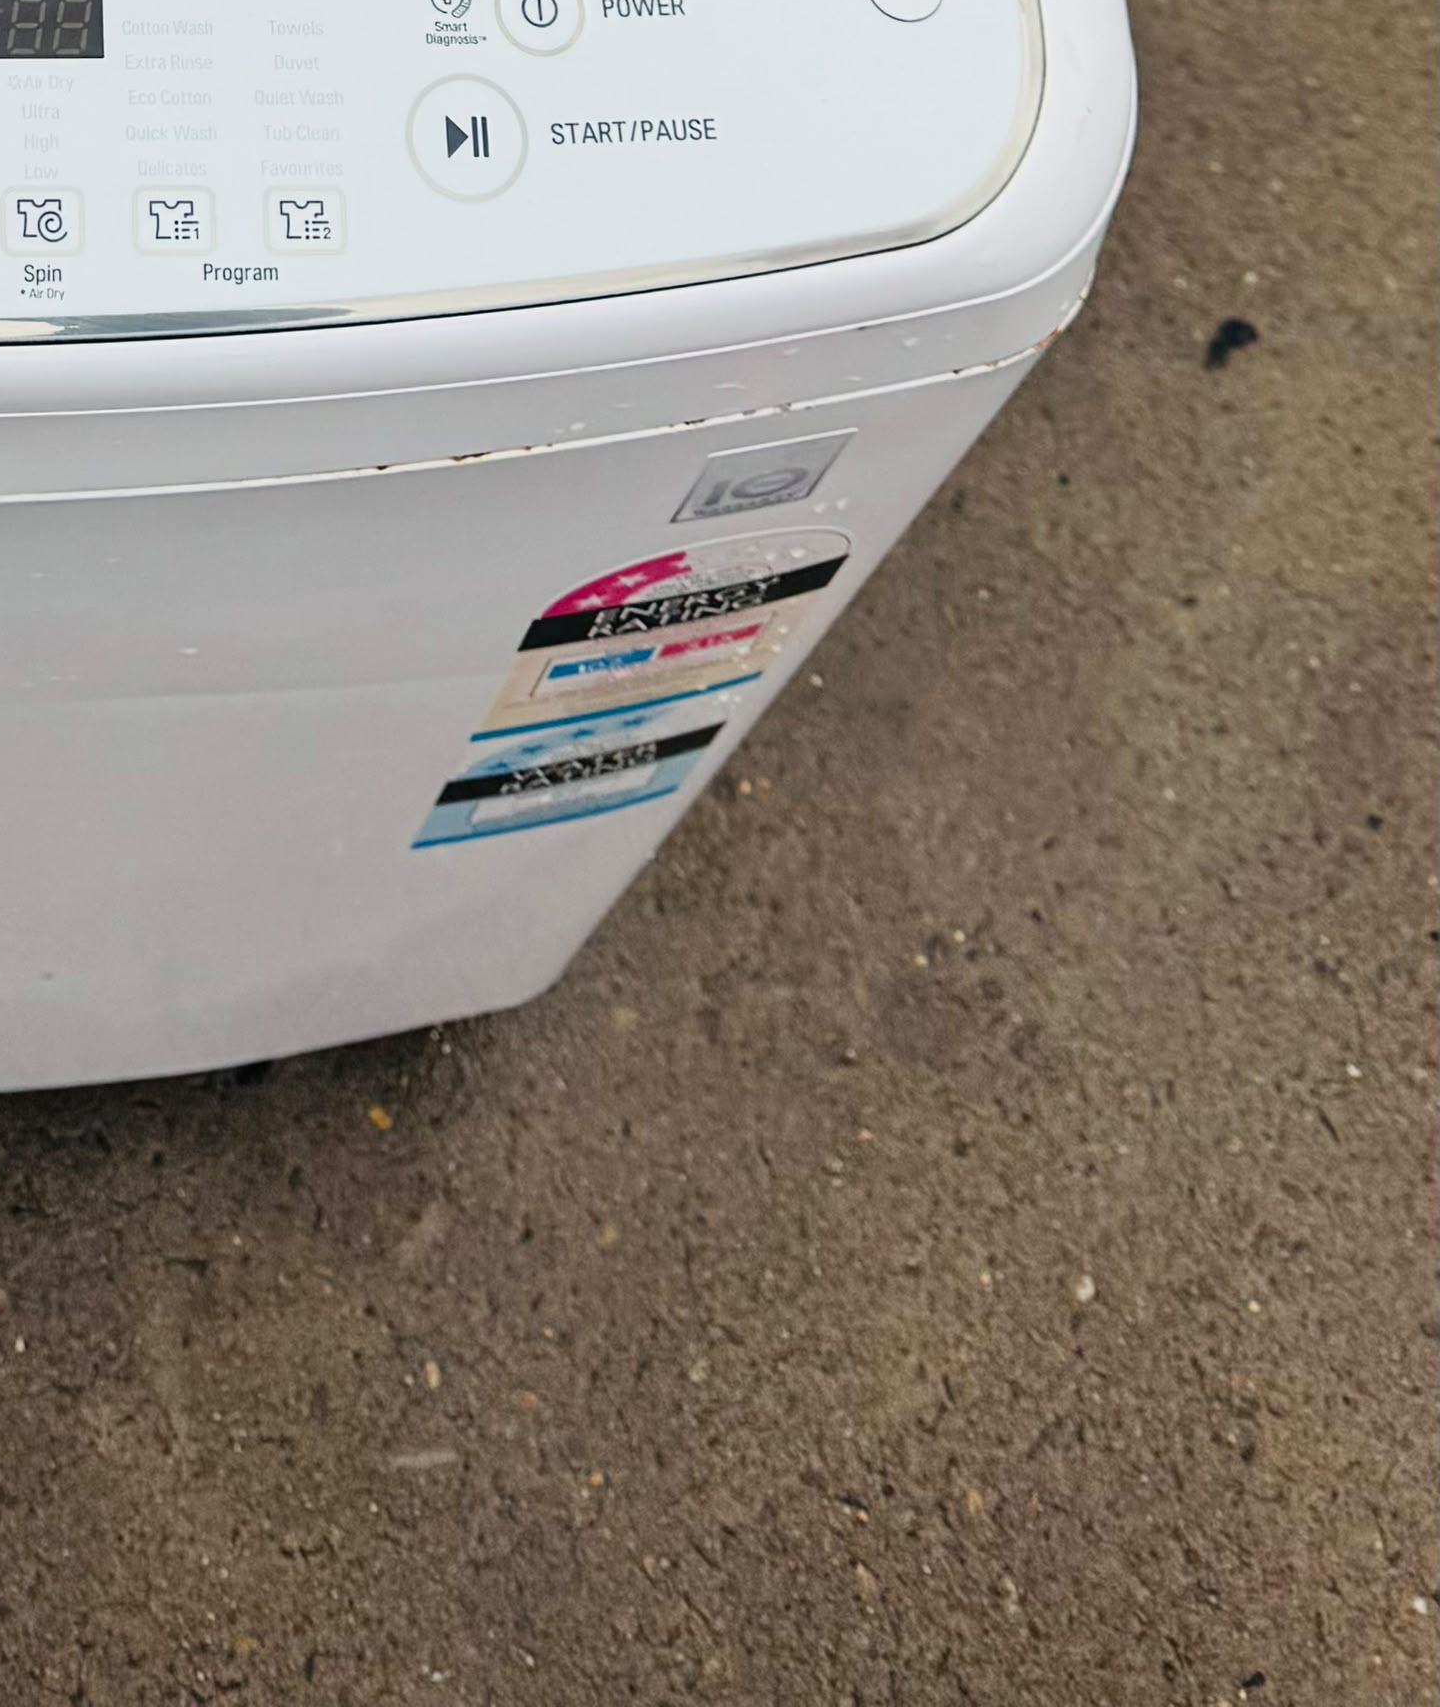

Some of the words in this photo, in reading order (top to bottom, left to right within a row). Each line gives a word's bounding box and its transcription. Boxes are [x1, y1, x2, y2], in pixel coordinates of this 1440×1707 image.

[121, 19, 169, 36] Cotton
[172, 19, 213, 36] Wash
[269, 19, 324, 36] Towels
[435, 21, 468, 33] Smart
[124, 54, 167, 70] Extra
[170, 54, 213, 70] Rinse
[274, 54, 320, 70] Duvet
[23, 75, 42, 90] Air
[48, 75, 75, 92] Dry
[128, 90, 156, 106] Eco
[160, 89, 212, 106] Cotton
[254, 90, 295, 107] Quiet
[299, 89, 344, 106] Wash
[21, 103, 60, 120] Ultra
[125, 124, 168, 141] Quick
[172, 124, 217, 141] Wash
[264, 124, 292, 140] Tub
[296, 124, 340, 141] Clean
[550, 118, 718, 145] START/PAUSE
[23, 132, 60, 153] High
[24, 163, 60, 180] Low
[137, 159, 207, 177] Delicates
[260, 159, 344, 177] Favourites
[23, 263, 63, 286] Spin
[203, 262, 279, 285] Program
[29, 288, 44, 299] Air
[47, 288, 65, 300] Dry
